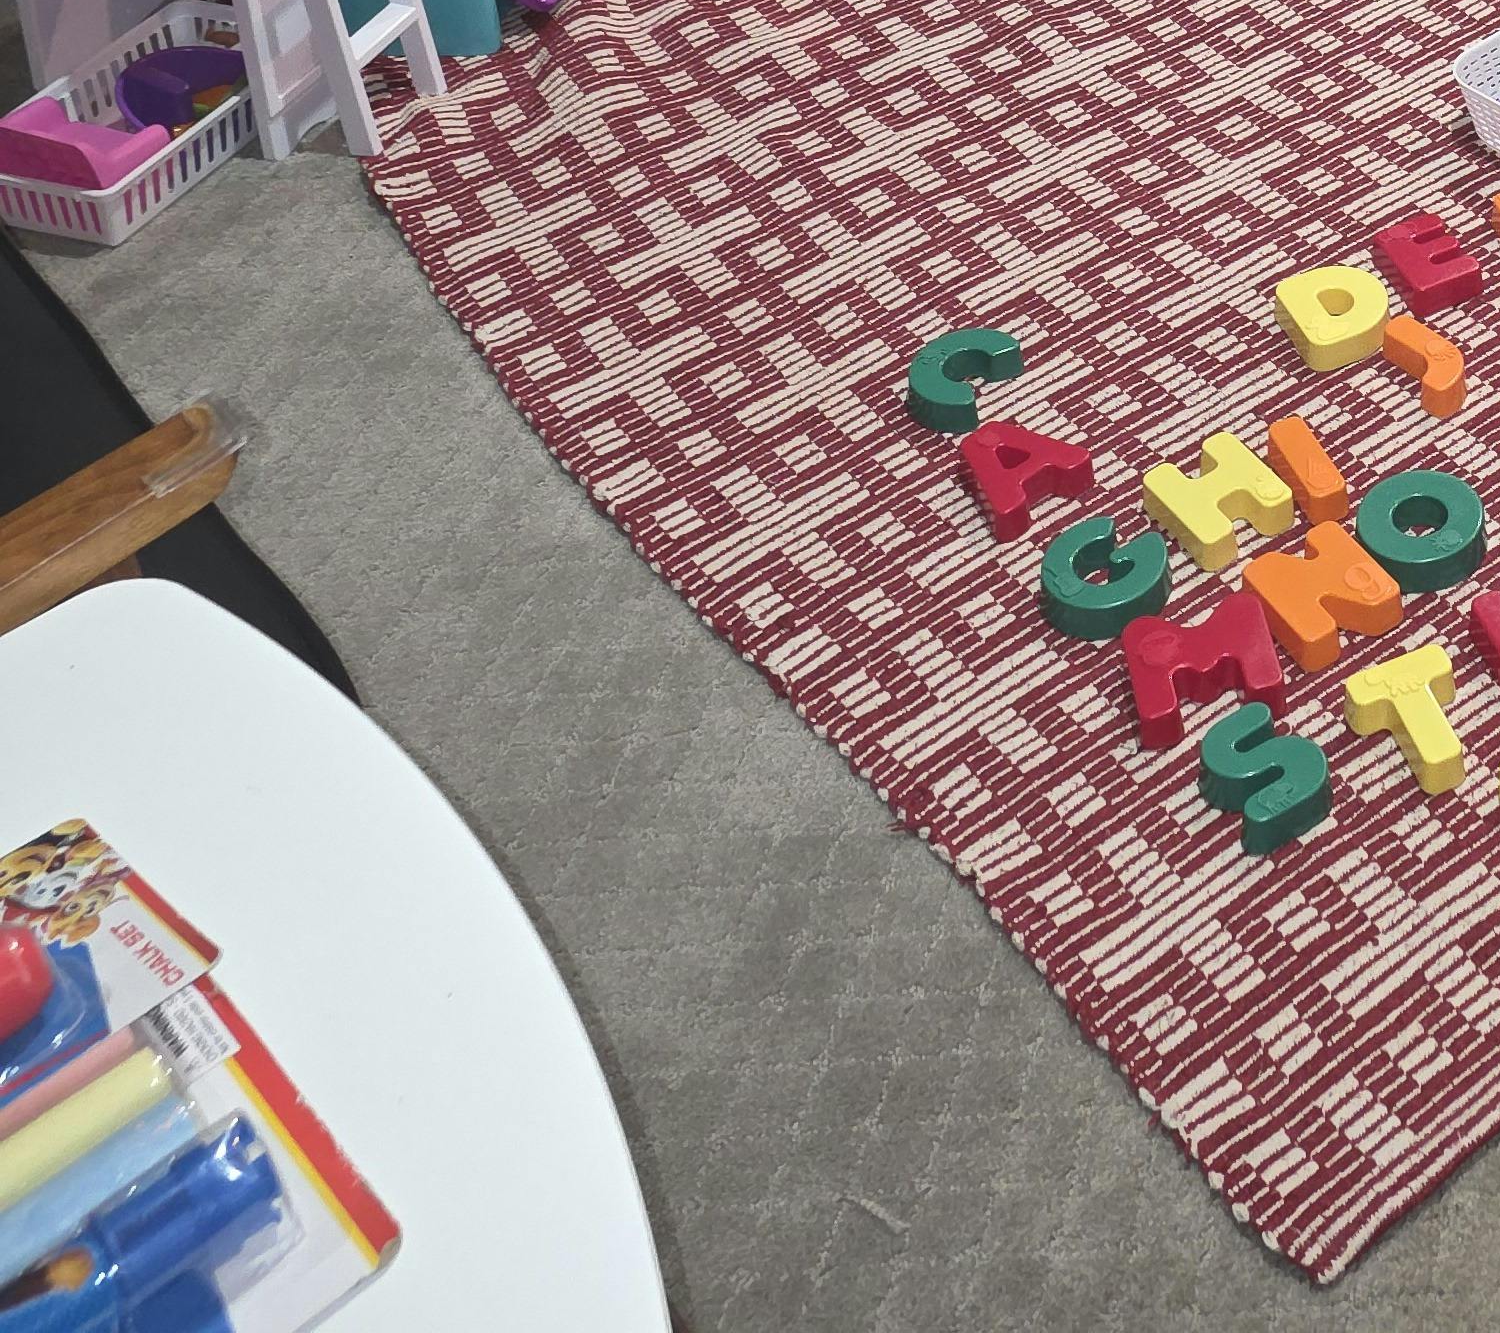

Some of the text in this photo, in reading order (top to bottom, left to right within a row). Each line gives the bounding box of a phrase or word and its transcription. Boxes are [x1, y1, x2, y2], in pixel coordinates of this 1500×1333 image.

[1275, 265, 1390, 372] D
[1374, 212, 1483, 317] E
[908, 327, 1022, 433] C
[959, 420, 1095, 543] A
[1142, 431, 1295, 572] H
[1355, 469, 1488, 593] O
[1040, 516, 1172, 640] G
[1241, 520, 1404, 674] N
[1120, 592, 1286, 751] M
[1344, 643, 1467, 797] T
[1200, 701, 1334, 857] S
[110, 919, 185, 986] CHALK SET
